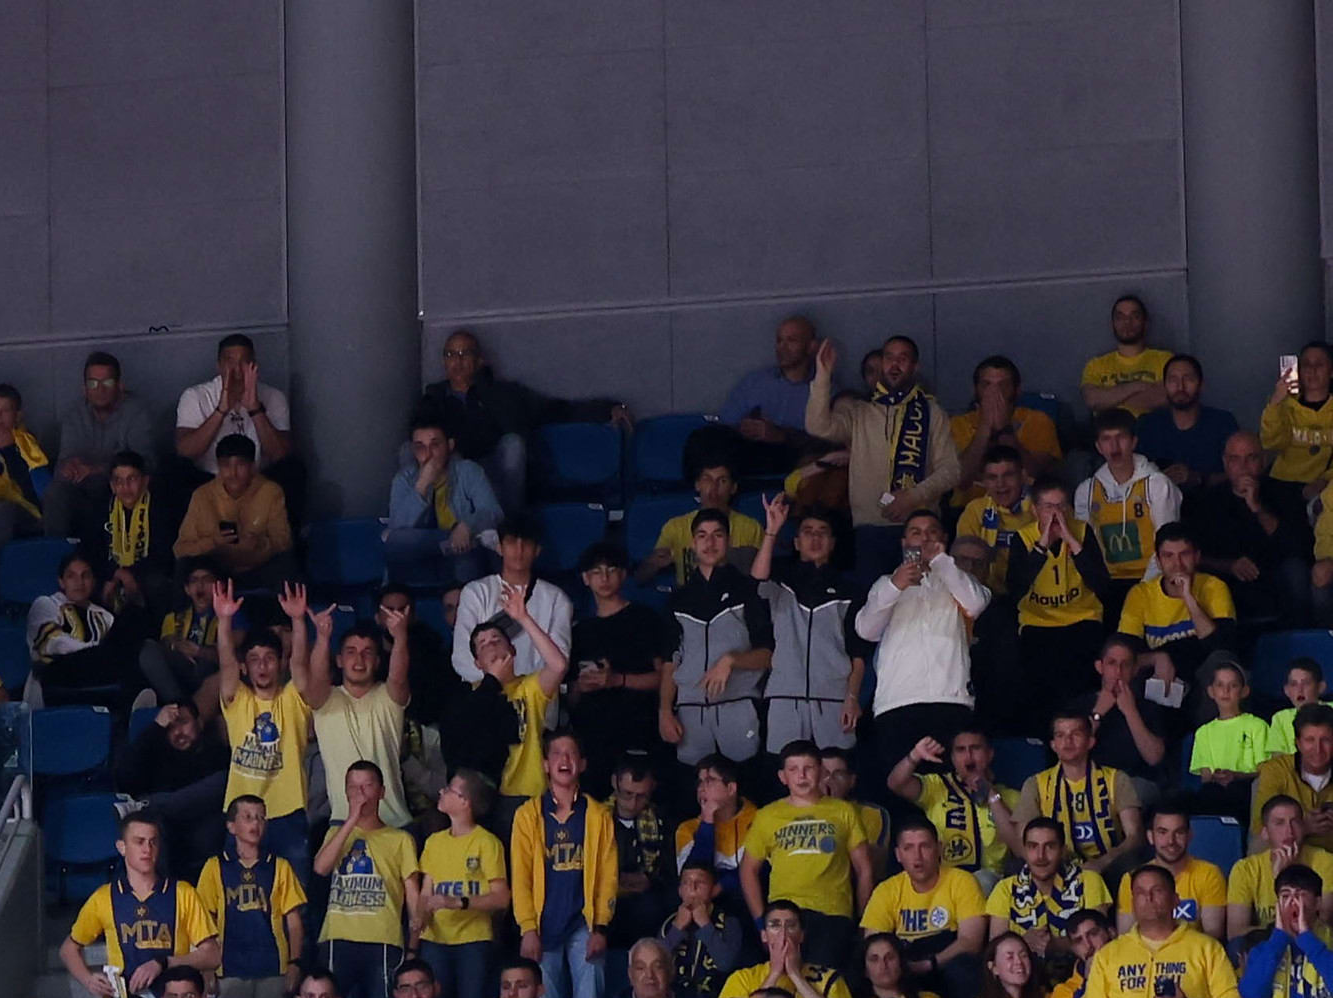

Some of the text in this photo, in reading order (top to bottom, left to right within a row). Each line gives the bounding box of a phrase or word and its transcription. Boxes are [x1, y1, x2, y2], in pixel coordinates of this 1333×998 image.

[332, 875, 384, 891] AXIMUM
[226, 882, 268, 912] MTA
[900, 909, 928, 932] THE
[120, 919, 172, 950] MTA
[1118, 962, 1186, 979] ANY THING
[1120, 976, 1146, 991] FOR
